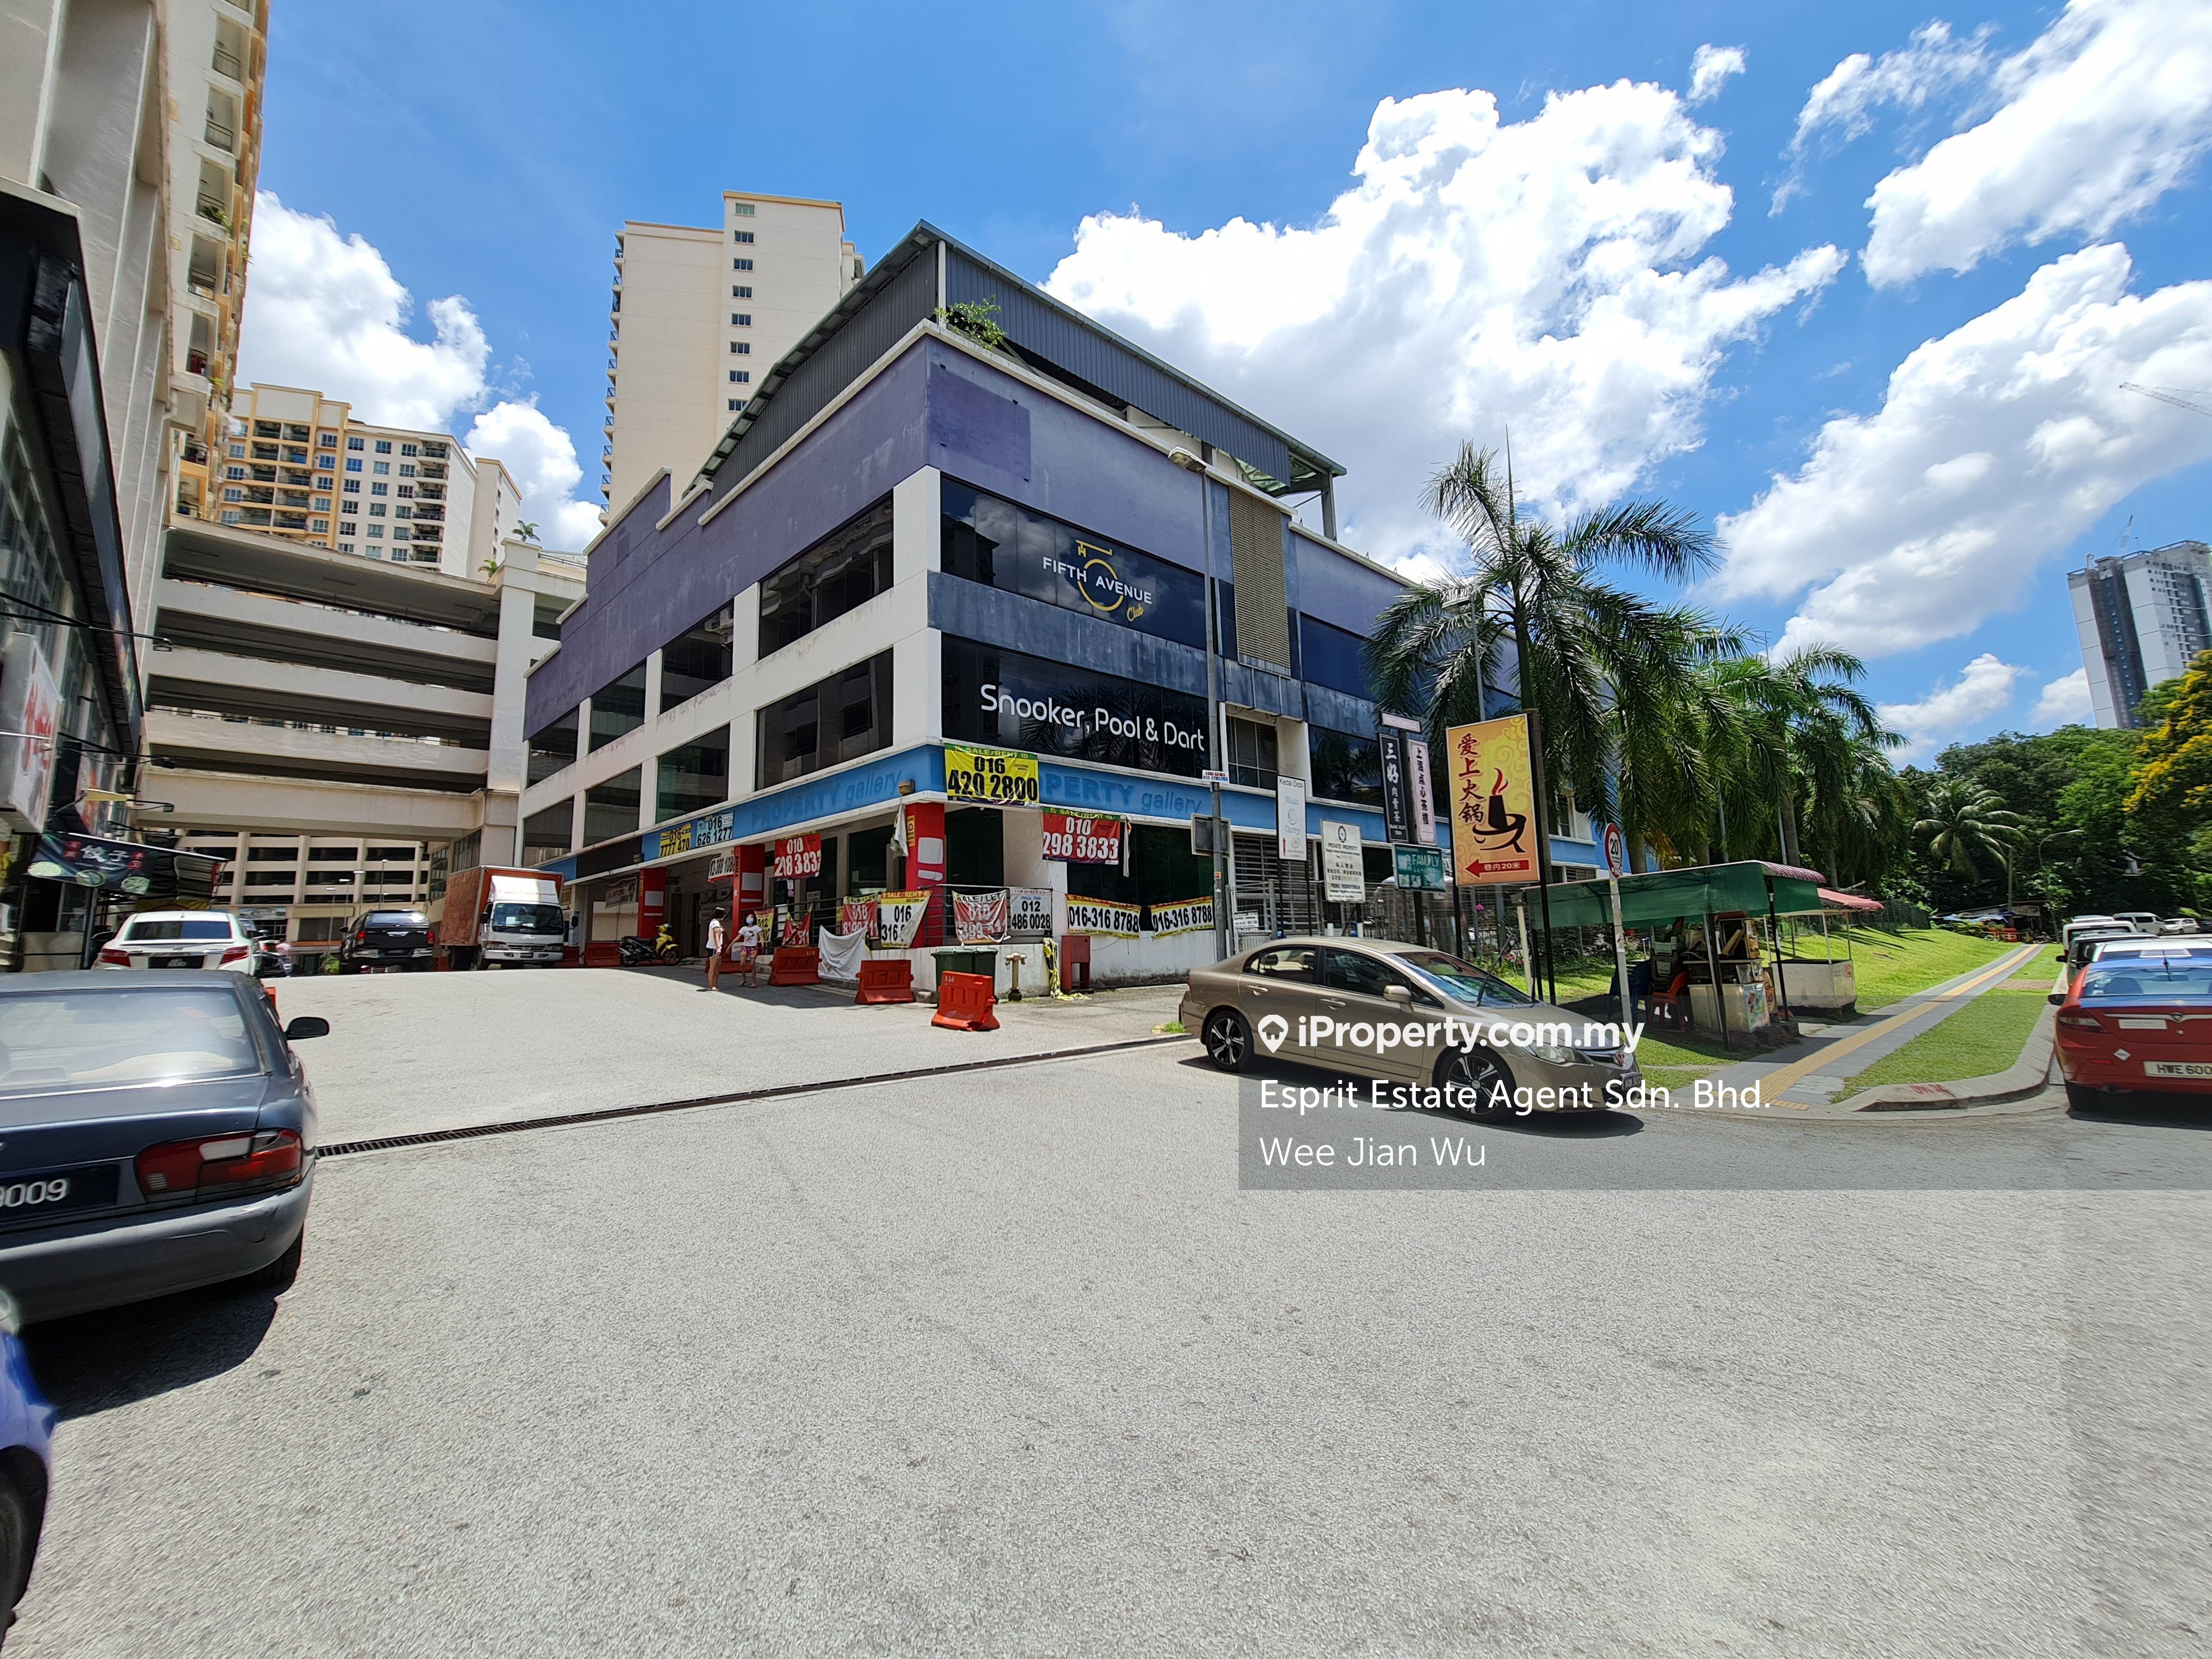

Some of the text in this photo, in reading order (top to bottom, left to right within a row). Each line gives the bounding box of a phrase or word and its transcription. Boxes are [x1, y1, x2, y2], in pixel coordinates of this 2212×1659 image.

[1042, 556, 1152, 604] FIFTH AVENUE
[1126, 604, 1144, 622] Club
[980, 684, 1204, 752] Snooker, Pool & Dart
[974, 756, 1005, 774] 016
[948, 769, 1038, 801] 420 2800
[1279, 777, 1292, 786] Kedai
[1457, 733, 1485, 823] 爱上火锅
[846, 770, 903, 806] gallery
[1040, 773, 1202, 813] PERTY gallery
[708, 815, 722, 831] 016
[1065, 817, 1092, 836] 010
[697, 826, 733, 846] 626 1277
[1042, 832, 1119, 859] 298 3833
[786, 837, 804, 855] 010
[1610, 838, 1619, 855] 20
[957, 894, 979, 902] SALE
[985, 893, 1002, 901] LET
[1021, 900, 1041, 912] 012
[894, 905, 912, 923] 016
[1011, 914, 1051, 930] 486 0028
[1068, 906, 1112, 930] 016-316
[1113, 910, 1140, 933] 8788
[1152, 906, 1190, 933] 016-316
[1191, 905, 1213, 925] 8788
[881, 924, 898, 941] 316
[0, 1178, 67, 1207] 009
